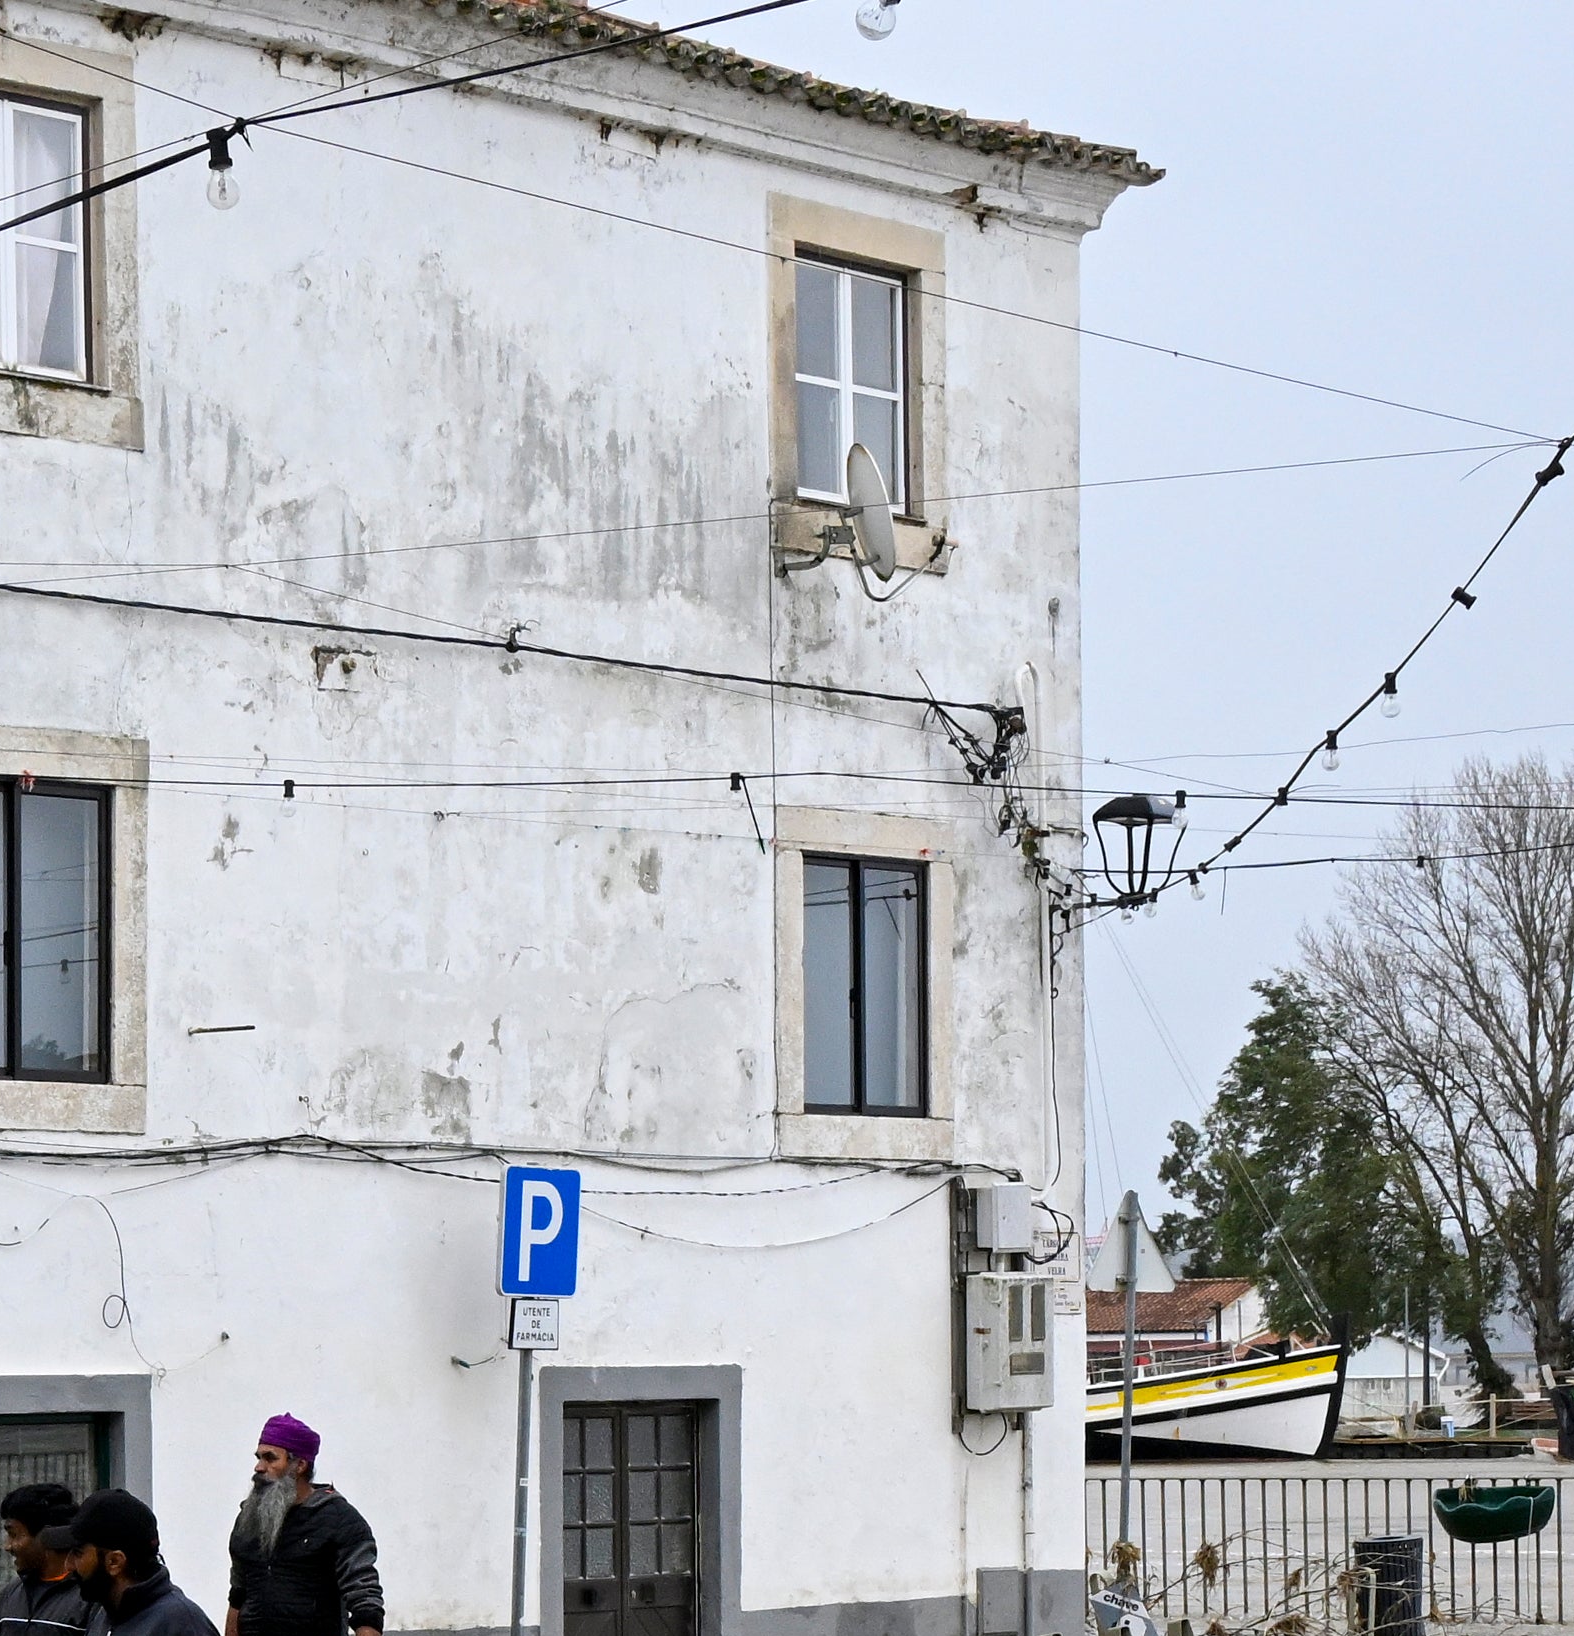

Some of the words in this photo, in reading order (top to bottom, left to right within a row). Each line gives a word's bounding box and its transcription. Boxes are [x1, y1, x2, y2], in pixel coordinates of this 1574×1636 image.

[518, 1180, 564, 1282] P
[522, 1307, 551, 1317] UTENTE
[531, 1319, 541, 1329] DE
[1103, 1593, 1139, 1612] chave
